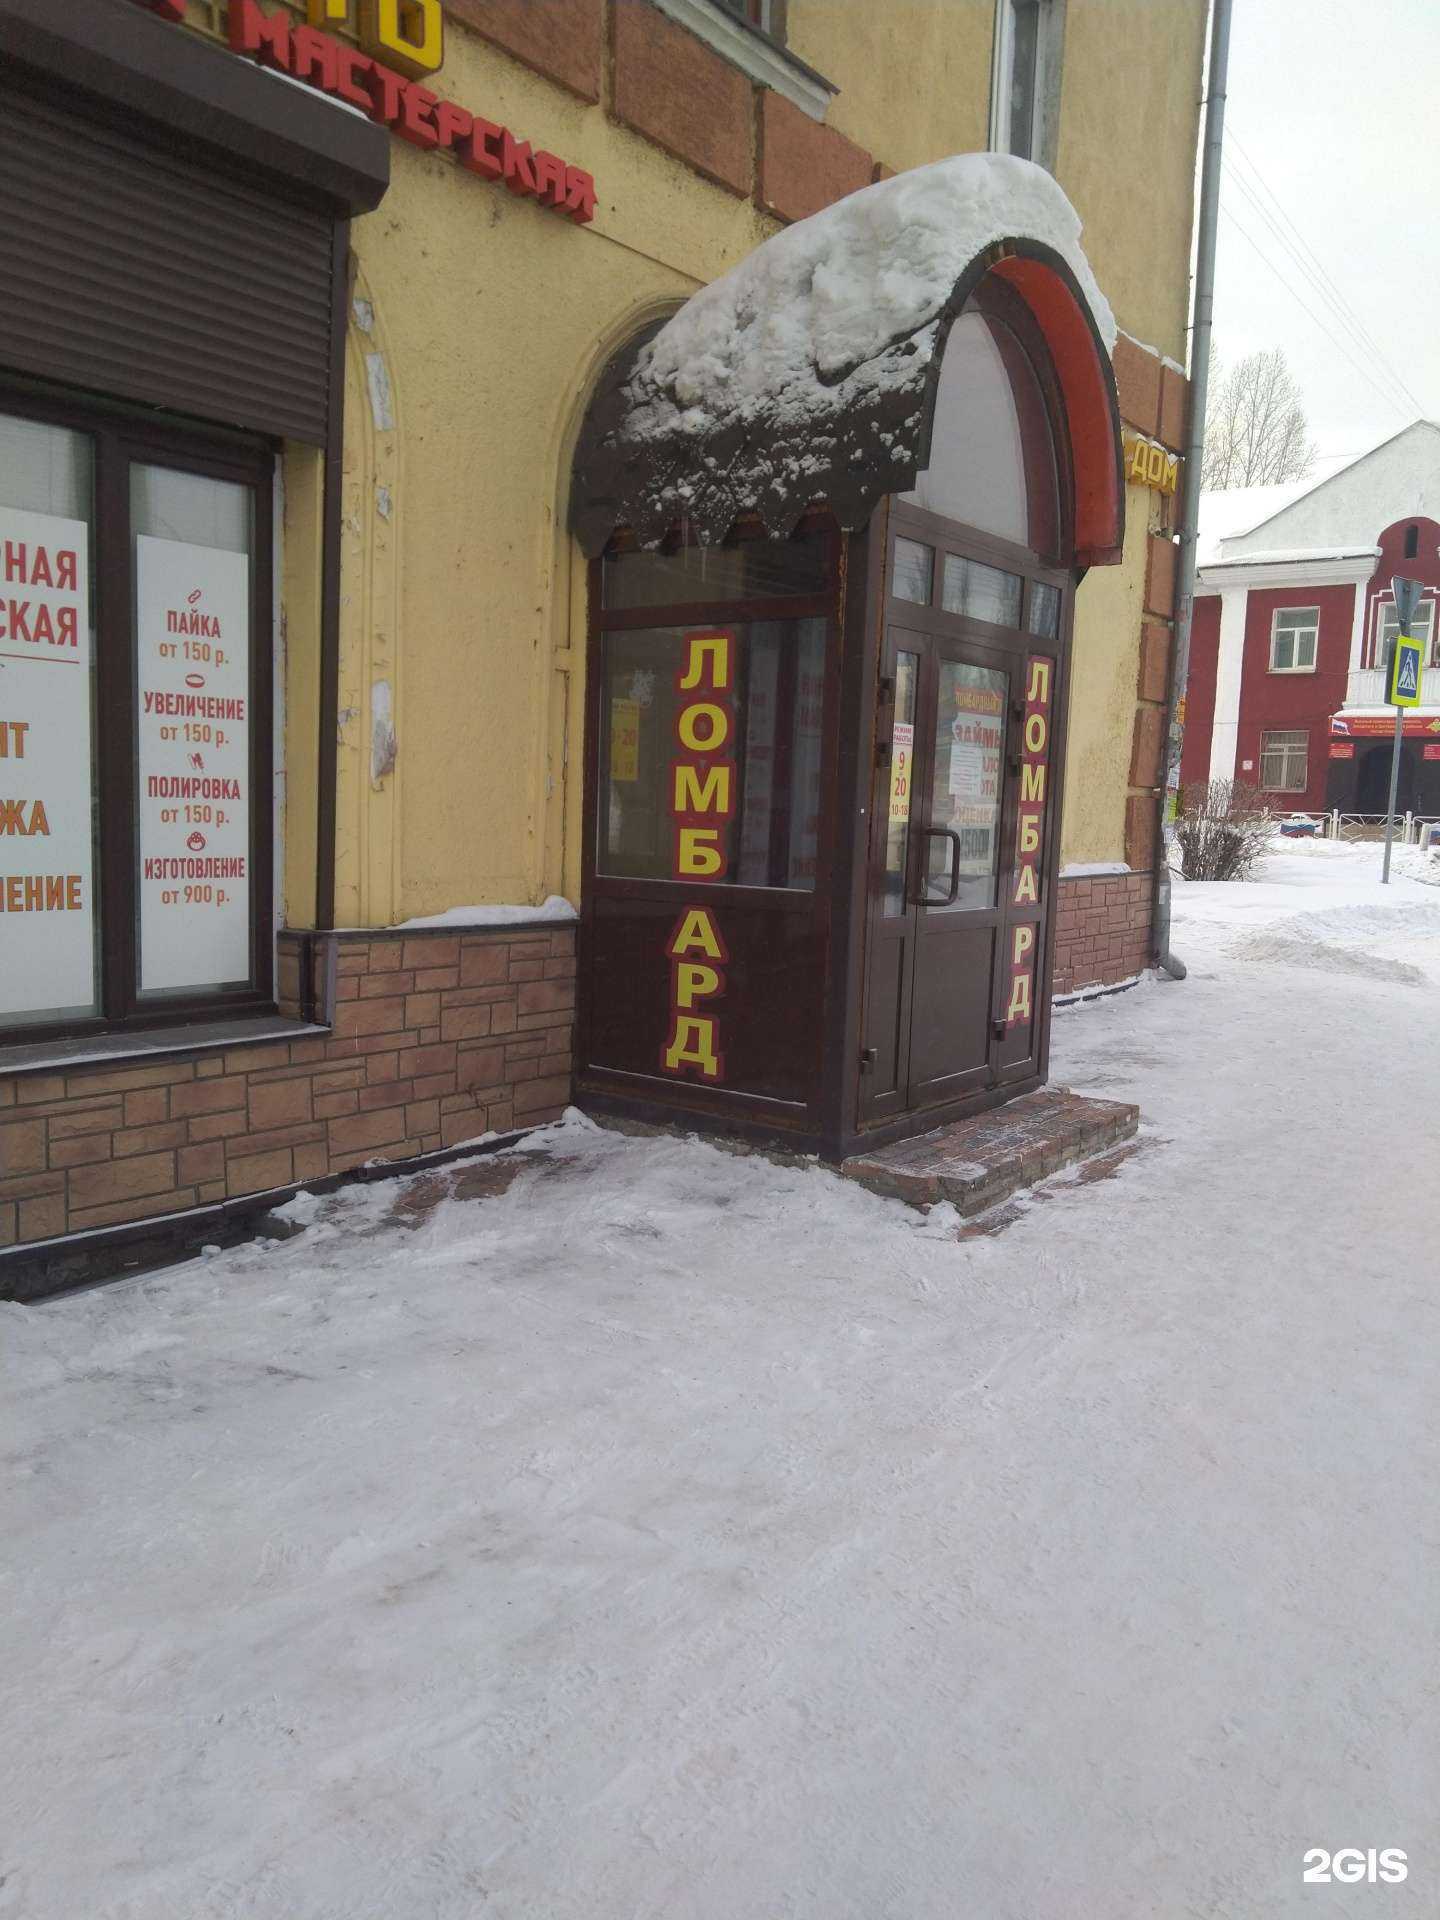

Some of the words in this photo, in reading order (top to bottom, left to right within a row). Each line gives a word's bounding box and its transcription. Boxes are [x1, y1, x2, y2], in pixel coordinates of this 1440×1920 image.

[231, 0, 598, 222] МАСТЕРСКАЯ
[1131, 439, 1178, 494] ДОМ
[0, 540, 77, 591] НАЯ
[167, 609, 221, 638] ПАЙКА
[159, 643, 177, 658] от
[183, 641, 211, 662] 150
[144, 691, 244, 720] УВЕЛИЧЕНИЕ
[160, 726, 178, 740] от
[184, 723, 211, 743] 150
[148, 776, 240, 799] ПОЛИРОВКА
[895, 777, 906, 797] 20
[161, 809, 179, 823] от
[184, 805, 212, 823] 150
[1007, 661, 1050, 1022] ЛОМБАРД
[144, 857, 245, 879] ИЗГОТОВЛЕНИЕ
[666, 637, 730, 1076] ЛОМБАРД
[162, 890, 179, 904] от
[184, 885, 212, 903] 900
